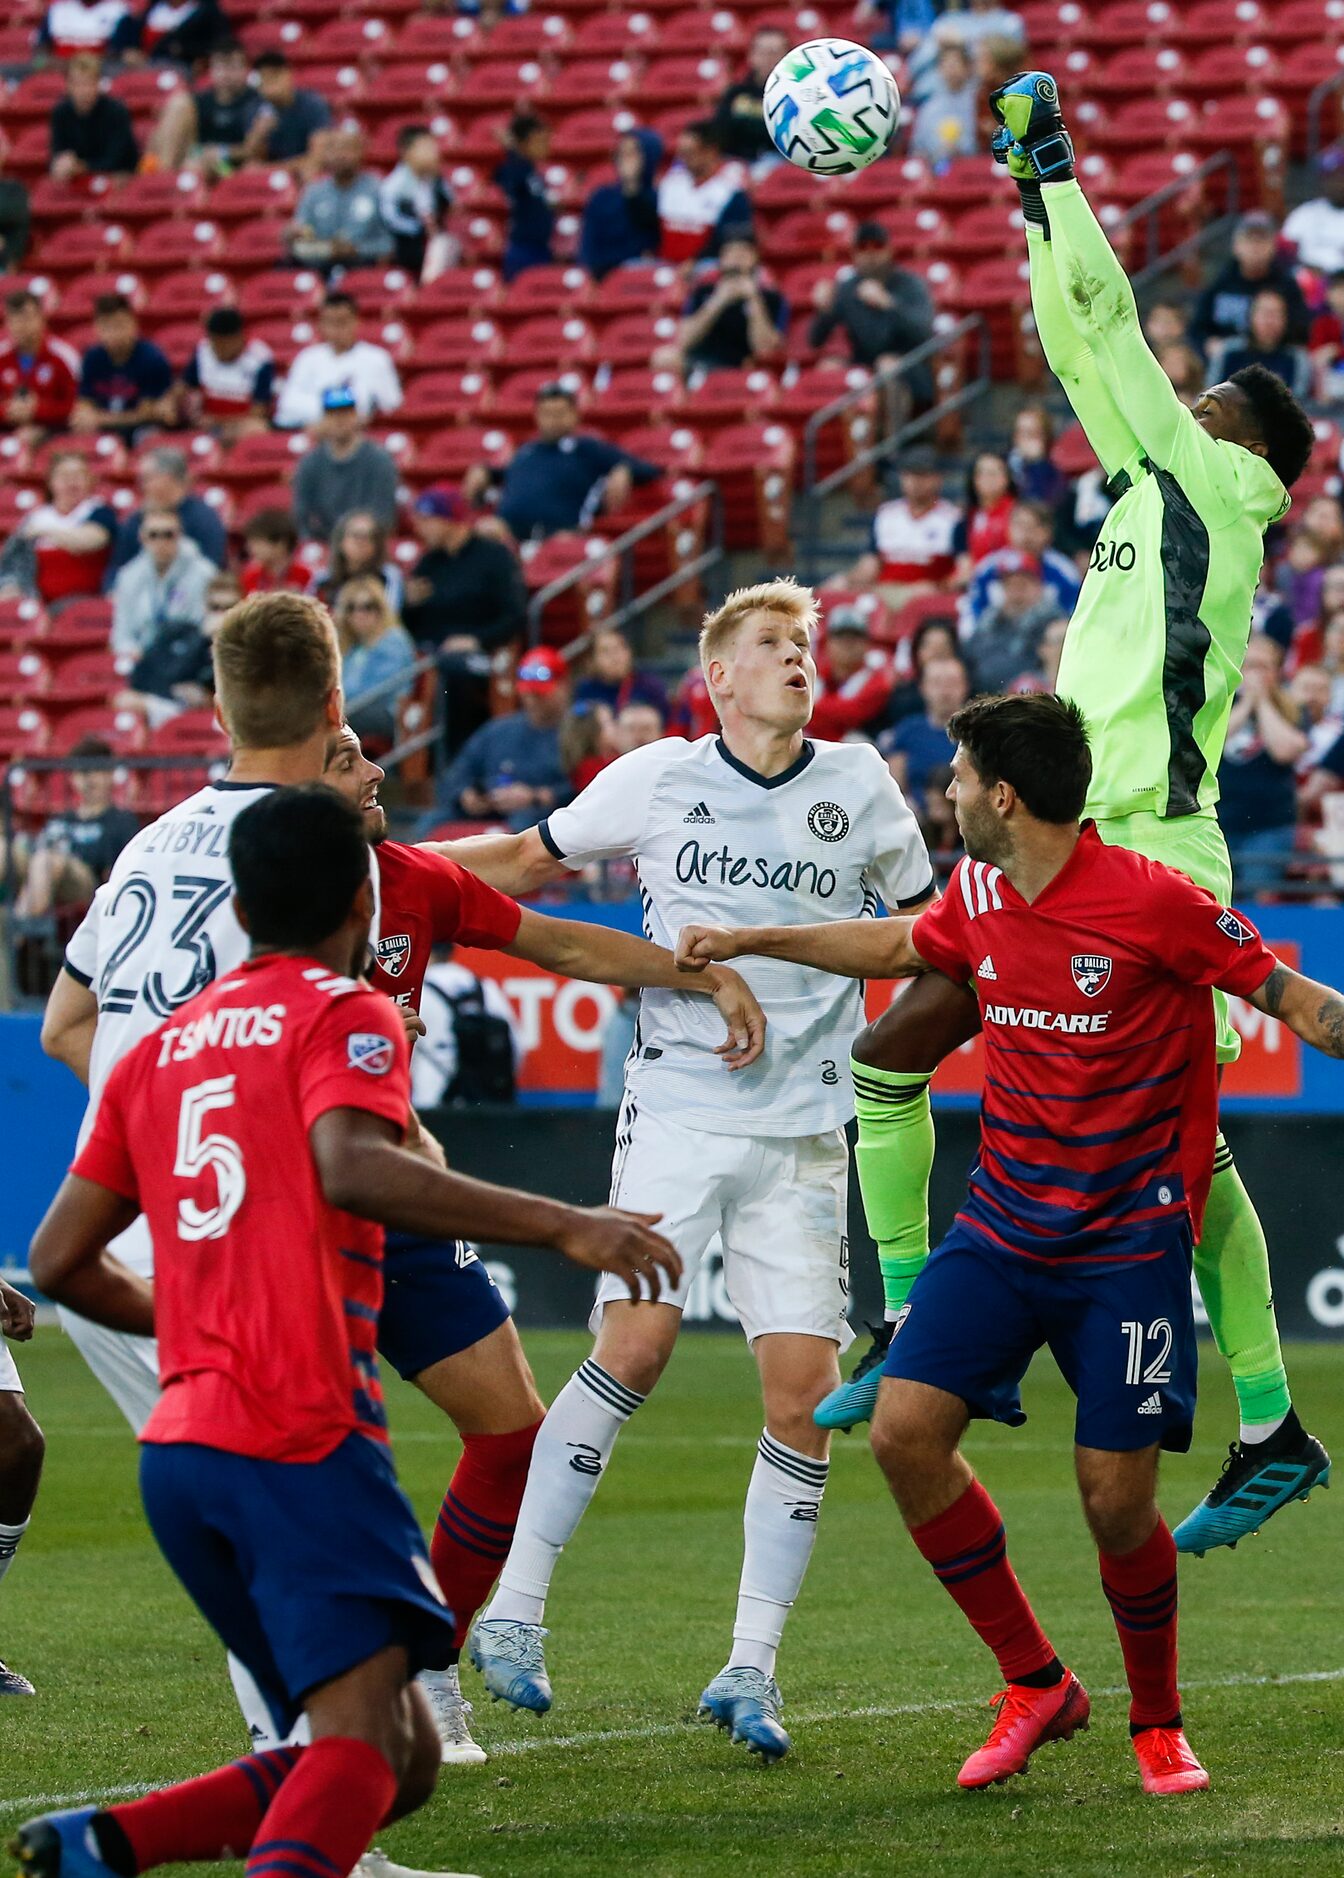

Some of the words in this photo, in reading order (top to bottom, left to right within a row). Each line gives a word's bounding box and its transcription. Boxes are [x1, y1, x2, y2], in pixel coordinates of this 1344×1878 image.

[144, 821, 233, 857] ZYBYL
[683, 816, 716, 824] adidas
[676, 840, 837, 899] Artesano
[100, 870, 233, 1019] 23
[1074, 958, 1083, 968] FC
[1084, 957, 1109, 970] DALLAS
[984, 1003, 1109, 1033] ADVOCARE
[173, 1073, 247, 1242] 5
[1120, 1317, 1173, 1386] 12
